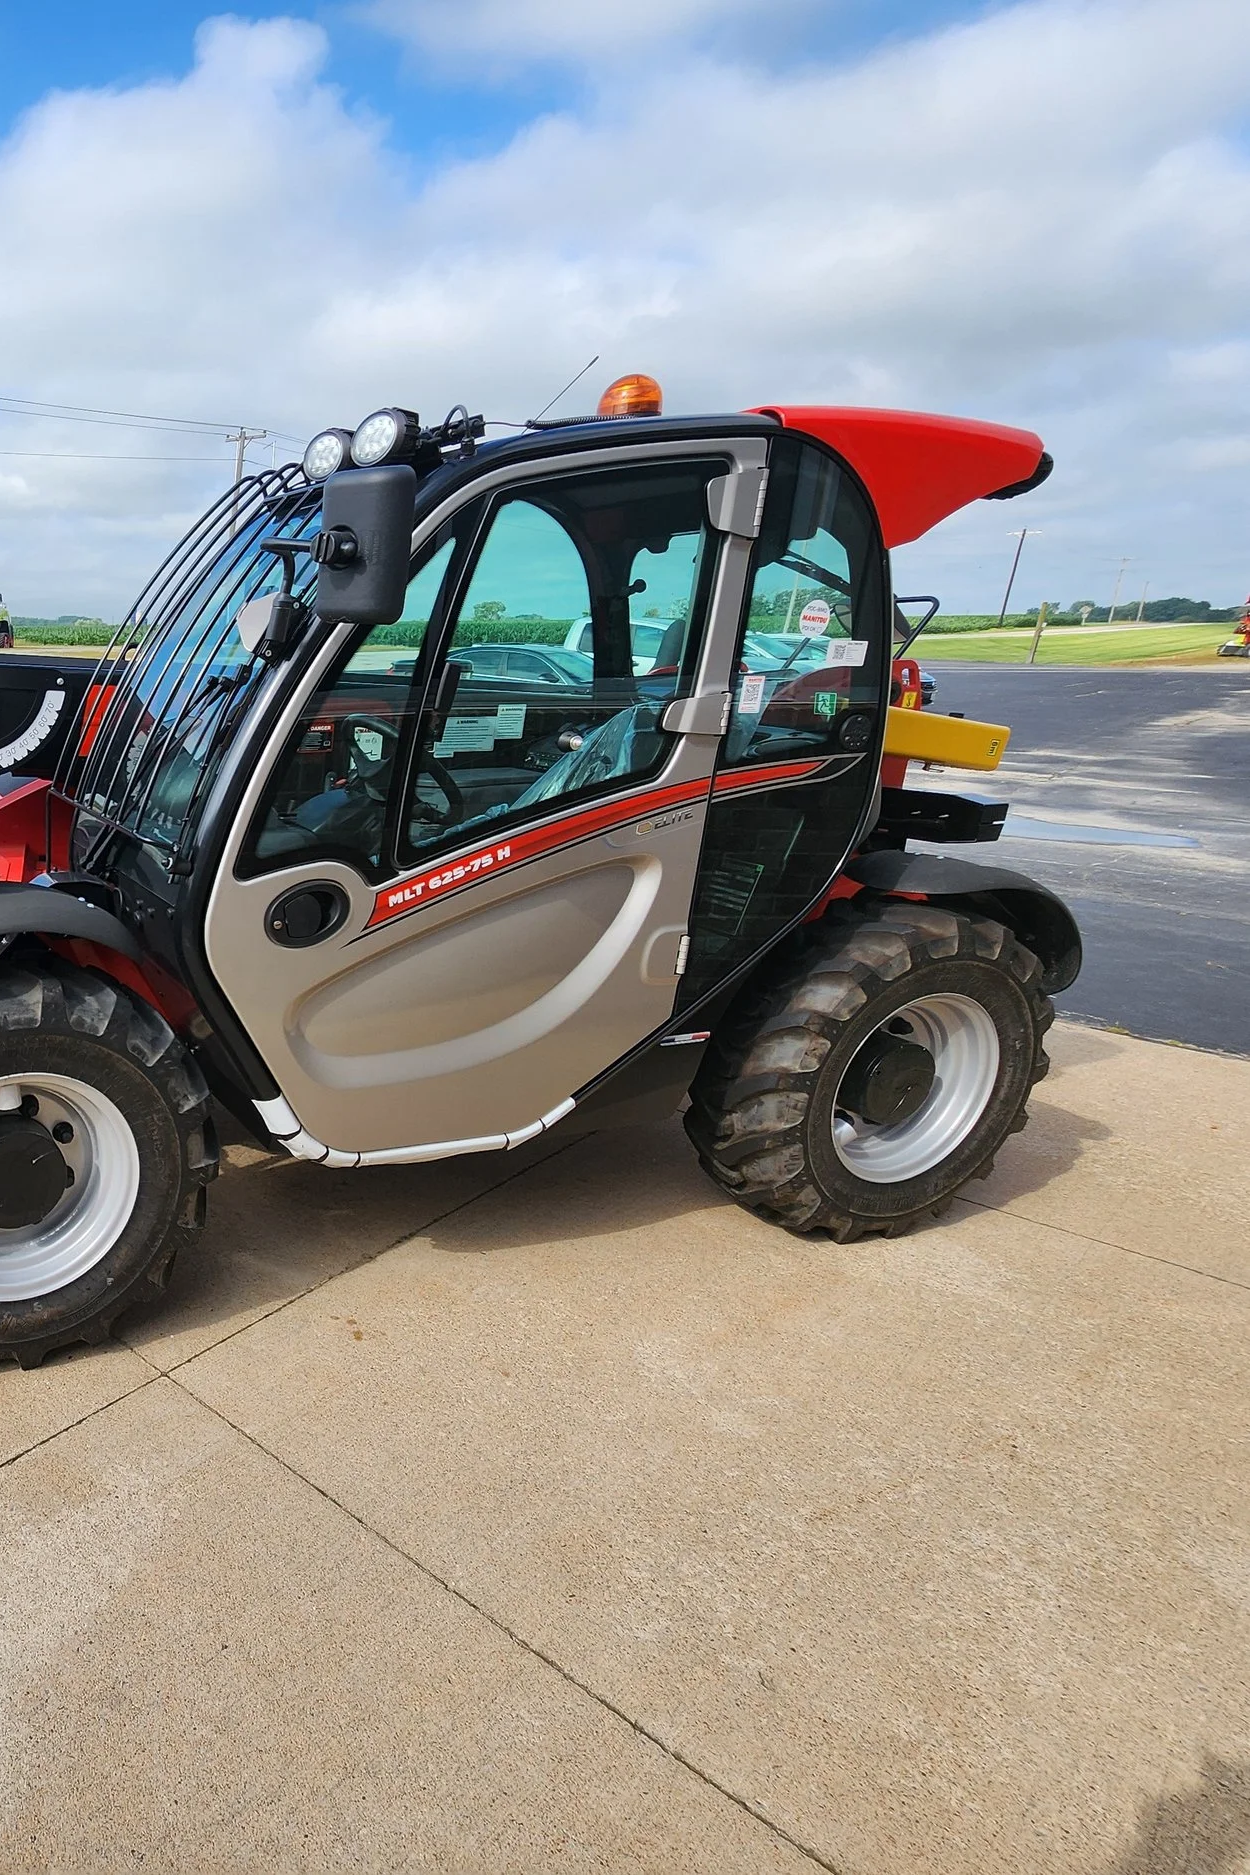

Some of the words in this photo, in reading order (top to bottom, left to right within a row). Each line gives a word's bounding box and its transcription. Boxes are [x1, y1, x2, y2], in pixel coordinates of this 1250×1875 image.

[802, 614, 828, 624] MANITOU
[654, 808, 694, 829] ELITE
[388, 882, 426, 907] MLT
[428, 854, 494, 890] 625-75
[496, 845, 511, 861] H
